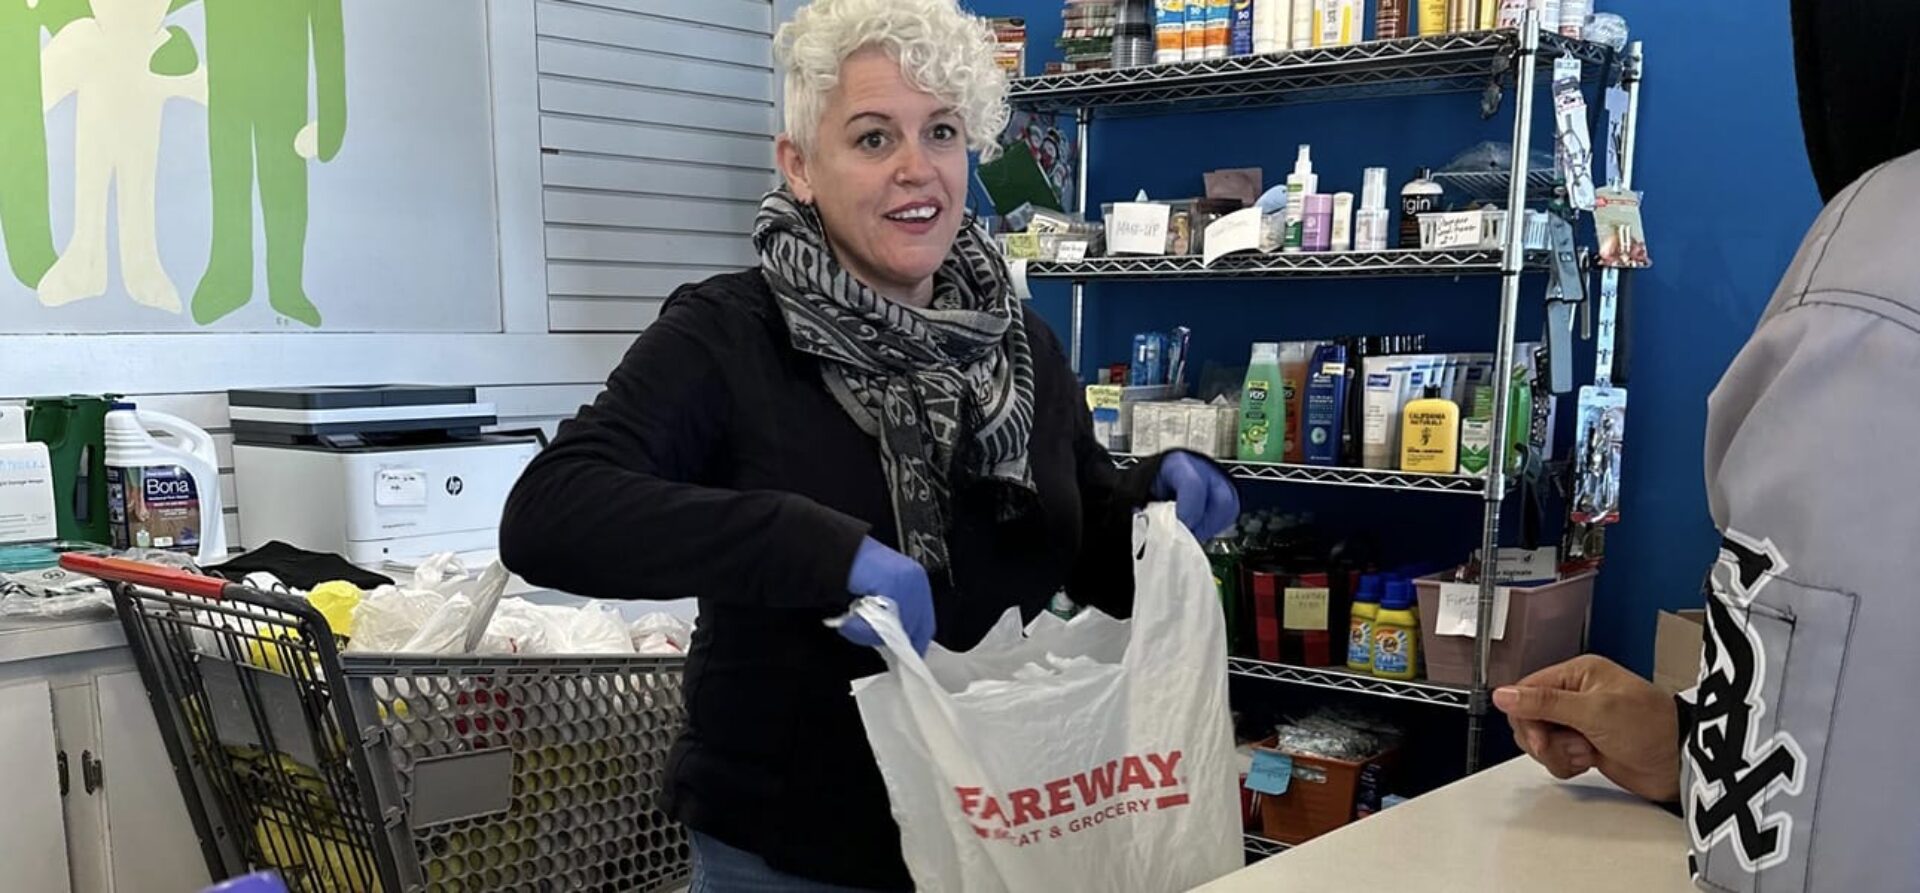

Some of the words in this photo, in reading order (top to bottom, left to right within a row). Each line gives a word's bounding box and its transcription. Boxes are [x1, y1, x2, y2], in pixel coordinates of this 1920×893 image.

[146, 478, 189, 494] Bona
[446, 476, 463, 496] hp
[954, 751, 1182, 828] FAREWAY
[1069, 799, 1150, 832] GROCERY
